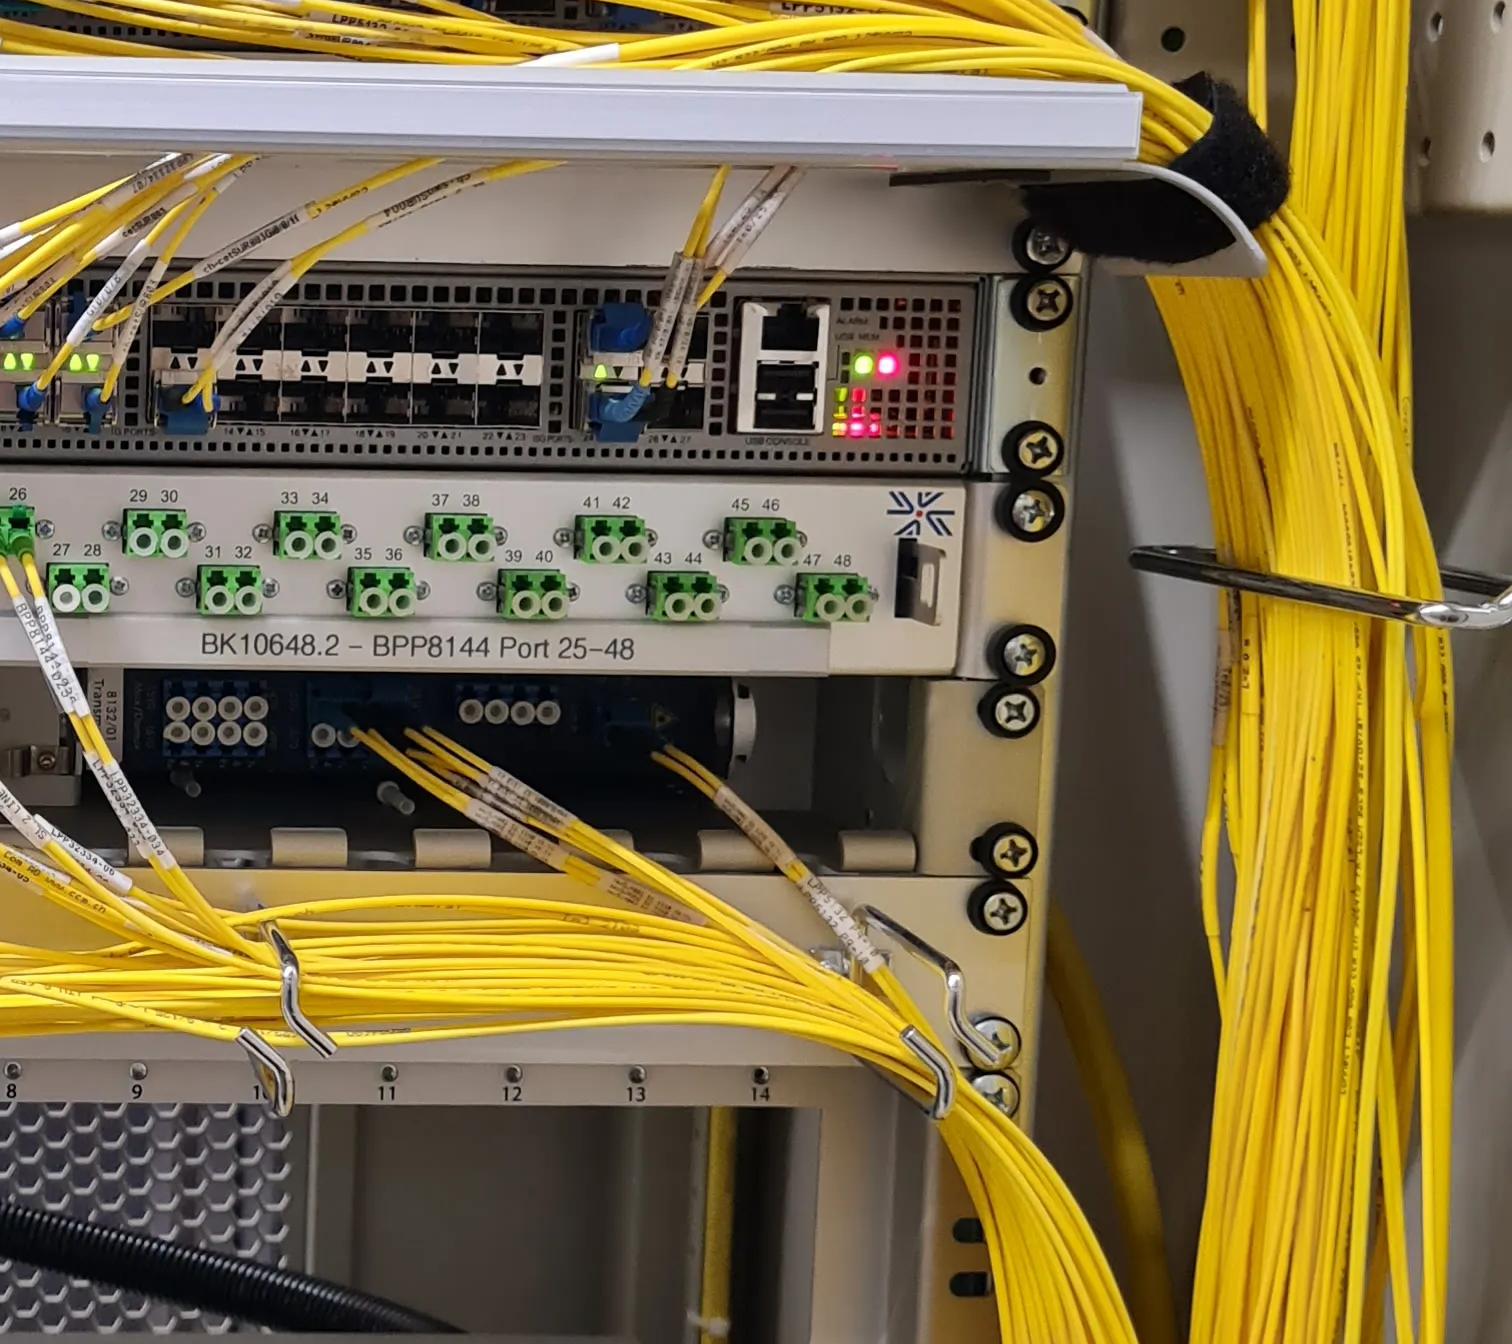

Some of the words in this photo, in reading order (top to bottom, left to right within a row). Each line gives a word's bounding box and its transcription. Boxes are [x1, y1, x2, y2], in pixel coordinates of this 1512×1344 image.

[766, 437, 810, 447] CONSOLE
[9, 488, 26, 501] 26
[130, 489, 147, 502] 29
[161, 490, 178, 503] 30
[281, 492, 298, 504] 33
[312, 492, 328, 504] 34
[432, 494, 449, 506] 37
[463, 494, 480, 507] 38
[583, 497, 598, 508] 41
[613, 497, 630, 509] 42
[732, 498, 749, 511] 45
[762, 499, 779, 511] 46
[202, 633, 339, 656] BK10648.2
[374, 635, 489, 658] BPP8144
[501, 637, 549, 658] Port
[106, 690, 118, 742] 8132/01
[7, 1084, 16, 1098] 8
[132, 1084, 142, 1099] 9
[379, 1086, 395, 1100] 11
[503, 1086, 521, 1101] 12
[627, 1087, 645, 1102] 13
[752, 1087, 770, 1101] 14
